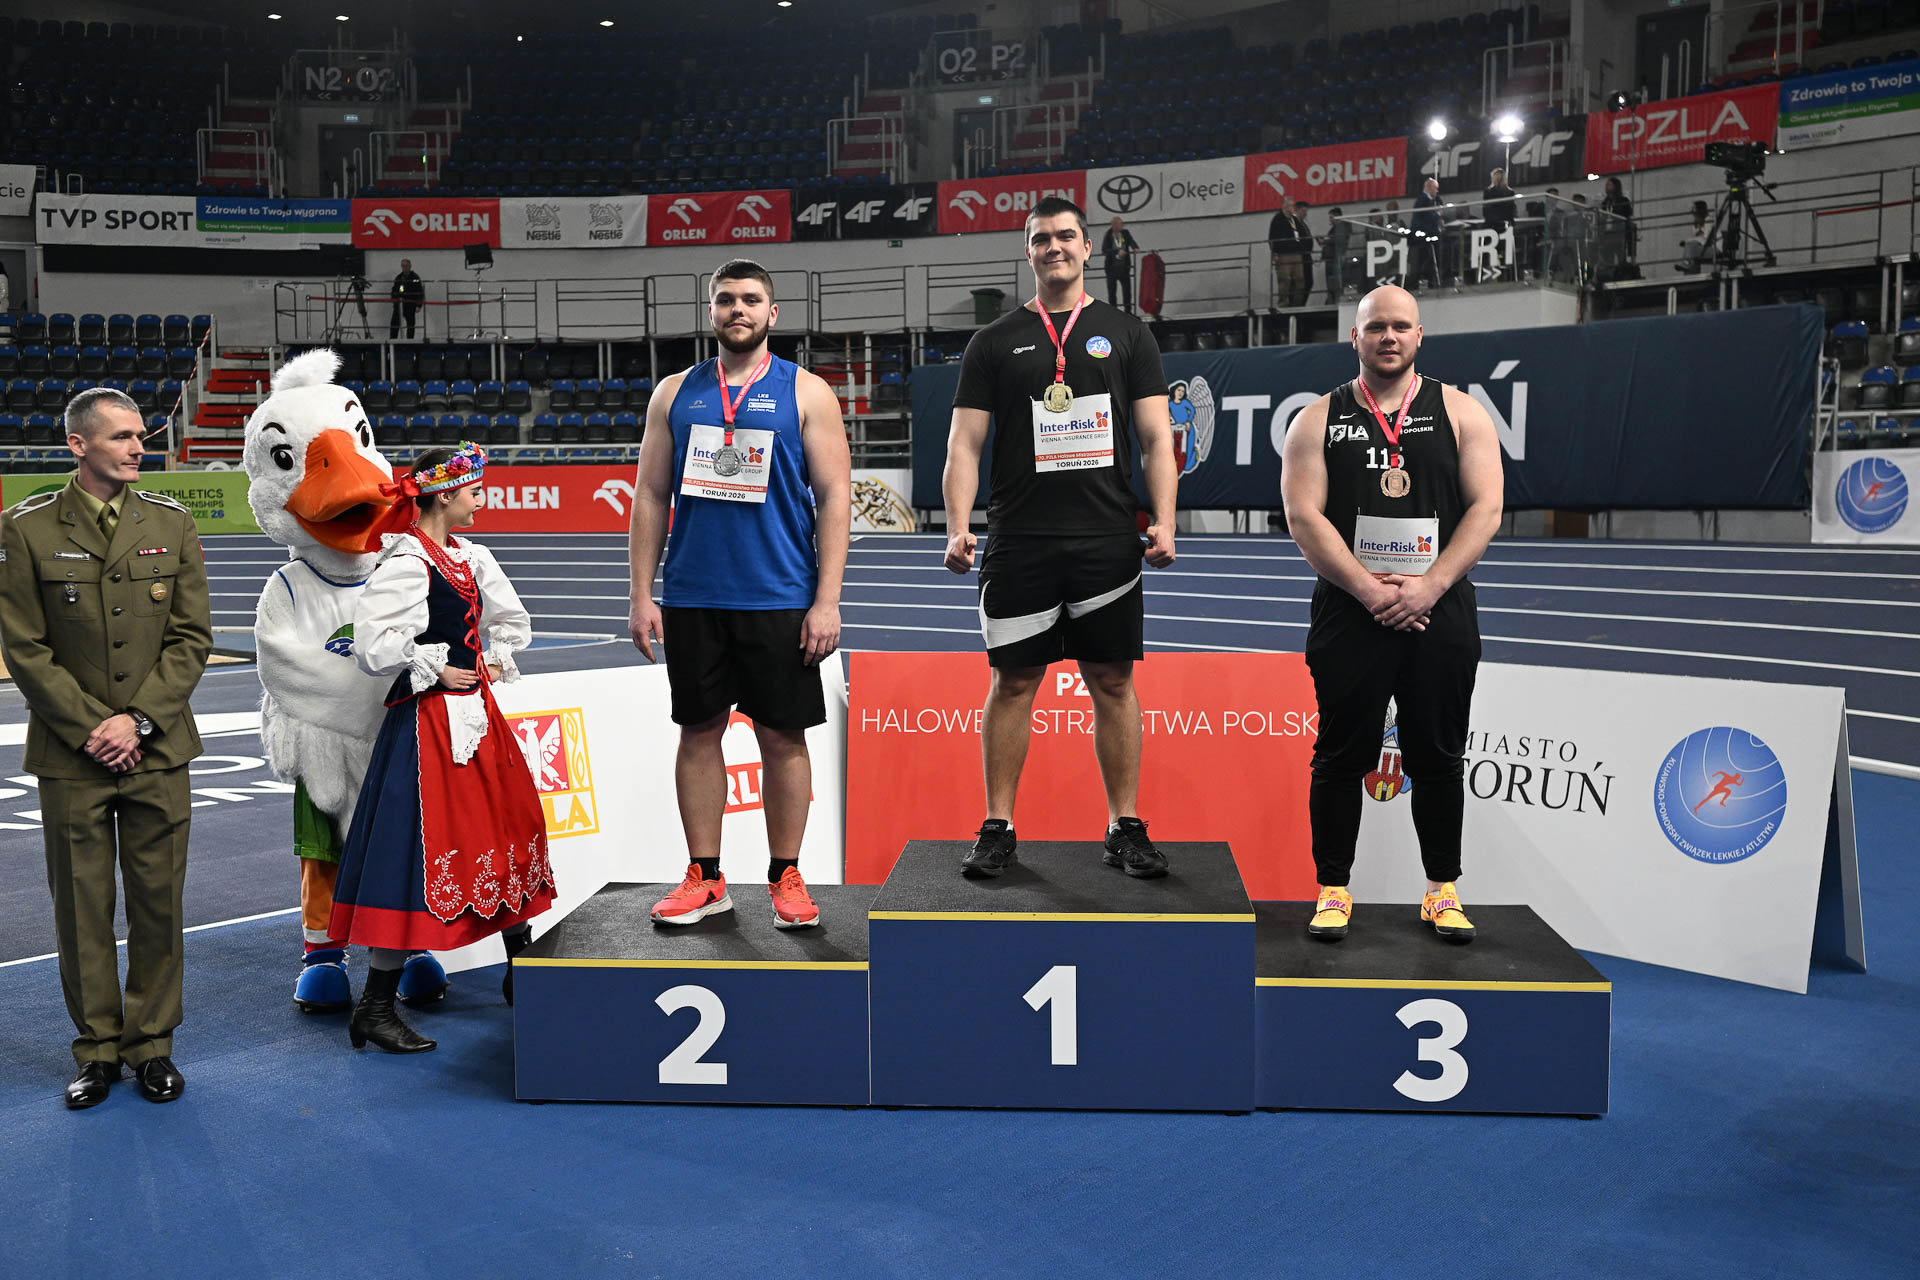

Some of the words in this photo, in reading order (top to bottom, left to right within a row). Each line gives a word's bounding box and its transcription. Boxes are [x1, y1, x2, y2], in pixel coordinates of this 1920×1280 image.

[305, 67, 342, 91] N2
[1791, 83, 1848, 102] Zdrowie
[1851, 82, 1866, 92] to
[1868, 73, 1912, 88] Twoja
[1612, 100, 1749, 150] PZLA
[1420, 142, 1480, 178] 4F
[1511, 131, 1574, 168] 4F
[1306, 156, 1394, 187] ORLEN
[0, 183, 25, 198] cie
[1169, 179, 1235, 201] Okęcie
[41, 208, 97, 229] TVP
[104, 209, 194, 231] SPORT
[205, 205, 247, 215] Zdrowie
[249, 206, 260, 215] to
[263, 207, 292, 217] Twoja
[294, 208, 338, 217] wygrana
[797, 202, 837, 225] 4F
[845, 200, 885, 223] 4F
[893, 197, 933, 221] 4F
[410, 213, 489, 232] ORLEN
[731, 226, 776, 238] ORLEN
[526, 229, 561, 240] Nestlé
[589, 229, 623, 240] Nestlé
[663, 228, 706, 241] ORLEN
[1366, 238, 1409, 277] P1
[1471, 226, 1514, 269] R1
[1040, 418, 1095, 433] InterRisk
[1403, 426, 1434, 434] OPOLSKIE
[691, 462, 712, 470] VIENNA
[693, 446, 748, 463] Intek
[1055, 459, 1082, 468] TORUŃ
[702, 489, 728, 498] TORUŃ
[728, 491, 746, 499] 2026
[1360, 539, 1416, 553] InterRisk
[862, 708, 984, 734] HALOWE
[1223, 711, 1319, 736] POLSK
[1657, 756, 1681, 842] KUJAWSKO-POMORSKI
[1678, 838, 1712, 860] ZWIĄZEK
[1713, 848, 1746, 861] LEKKIEJ
[1746, 821, 1776, 853] ATLETYKI
[1023, 966, 1076, 1065] 1
[655, 985, 727, 1084] 2
[1393, 999, 1468, 1101] 3
